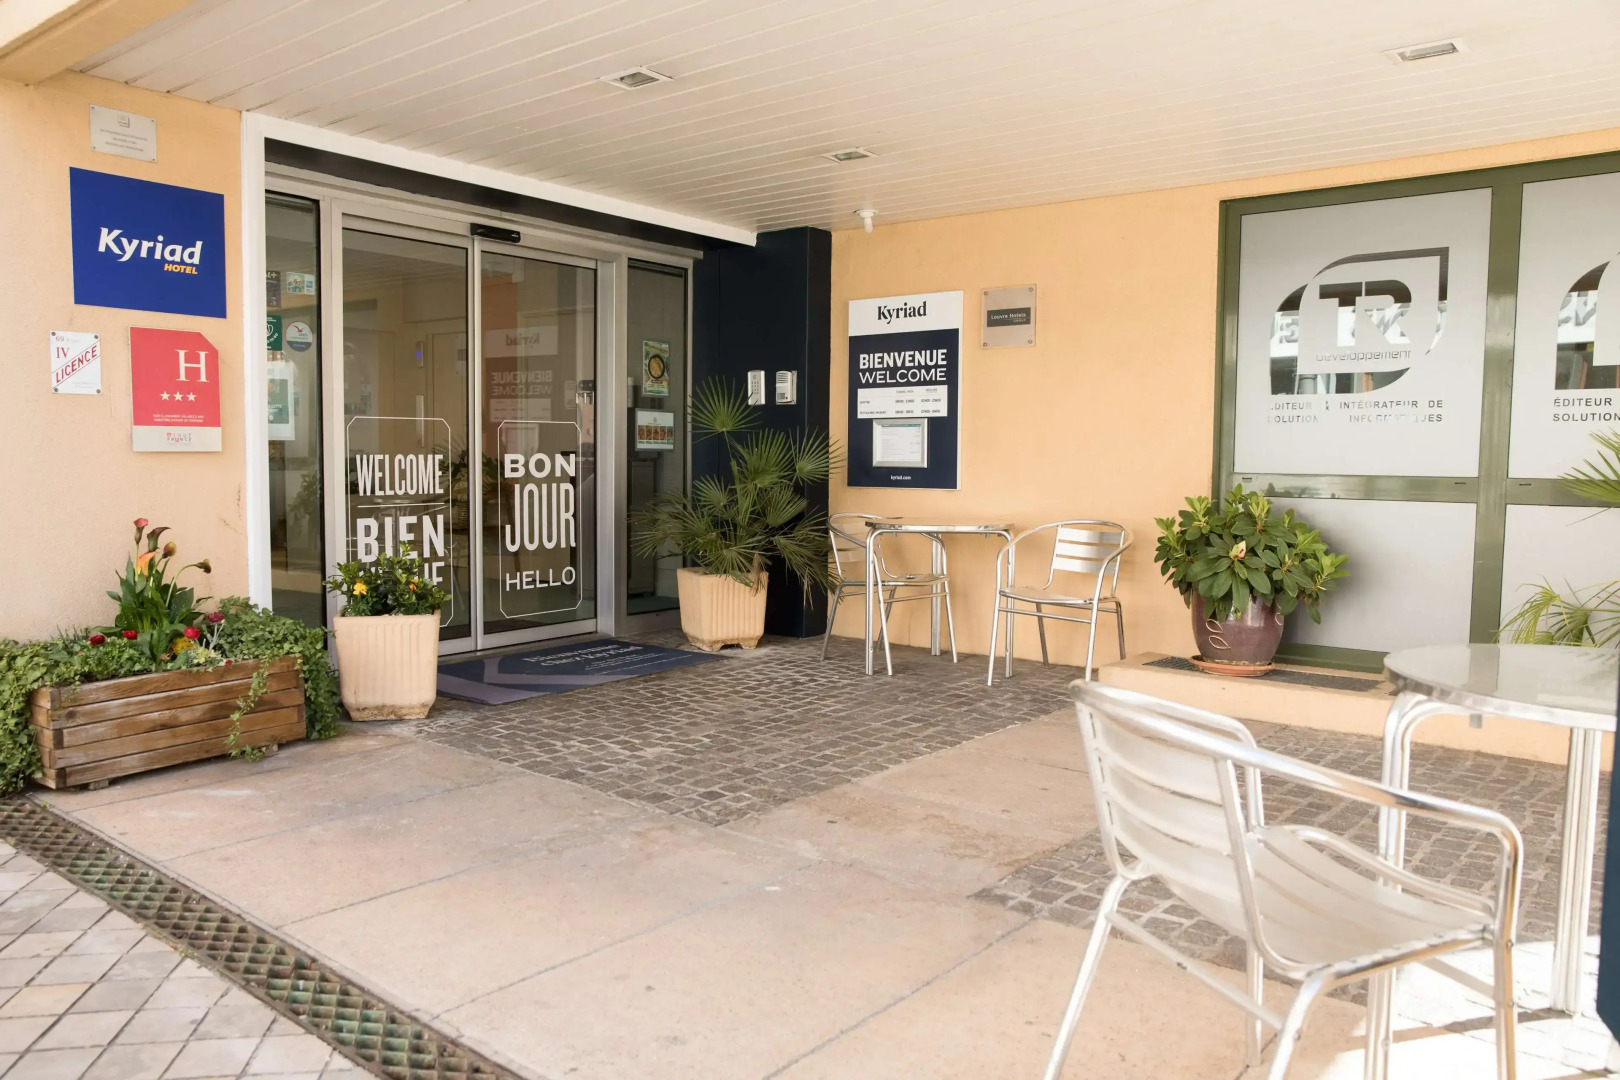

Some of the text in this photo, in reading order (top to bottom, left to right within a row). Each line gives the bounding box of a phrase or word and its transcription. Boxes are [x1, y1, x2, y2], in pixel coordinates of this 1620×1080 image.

[98, 227, 203, 264] Kyriad
[164, 263, 198, 274] HOTEL
[877, 301, 927, 324] Kyriad
[55, 345, 98, 384] LICENCE
[56, 347, 70, 359] IV
[859, 349, 947, 369] BIENVENUE
[175, 349, 210, 382] H
[859, 368, 947, 384] WELCOME
[1271, 402, 1312, 410] DITEUR
[1428, 400, 1443, 408] DE
[1553, 396, 1612, 407] ÉDITEUR
[1267, 415, 1318, 423] OLUTION
[356, 454, 444, 496] WELCOME
[504, 453, 576, 478] BON
[505, 483, 576, 552] JOUR
[356, 515, 445, 563] BIEN
[505, 566, 576, 592] HELLO
